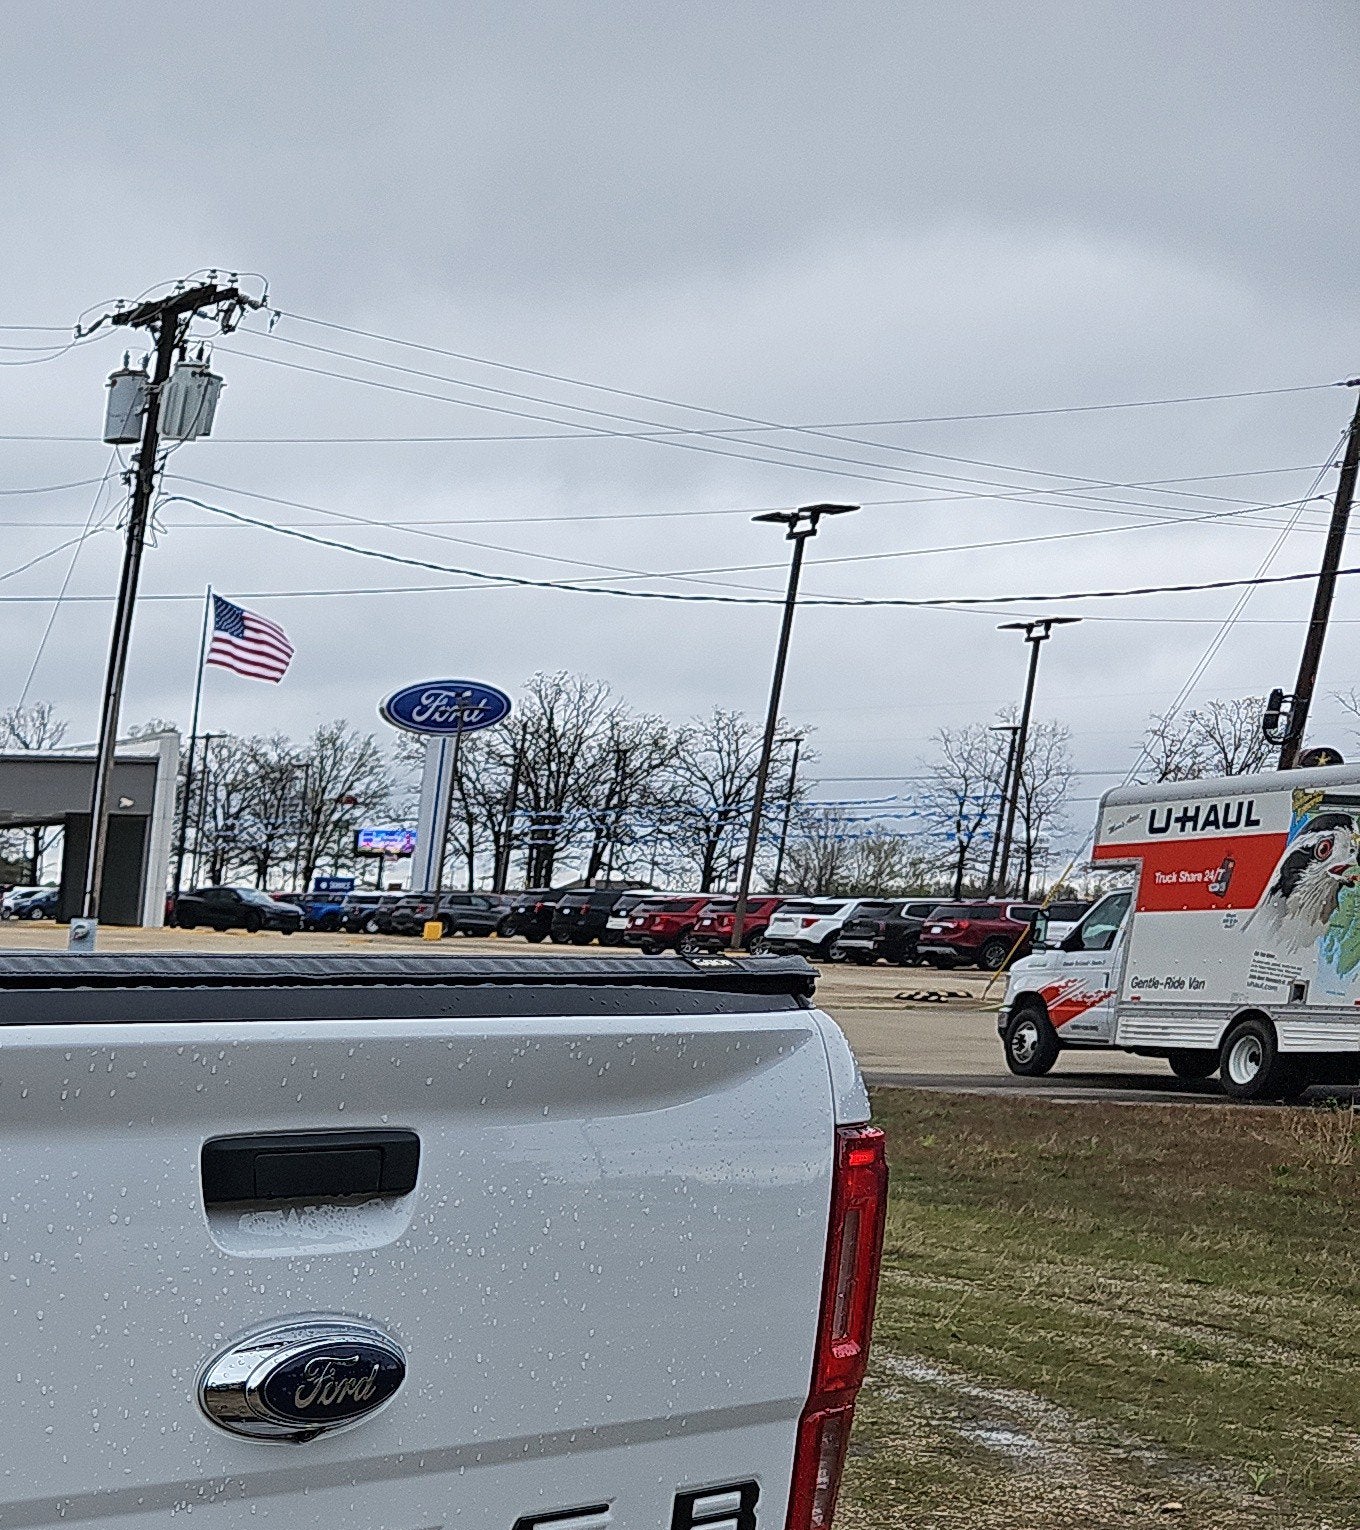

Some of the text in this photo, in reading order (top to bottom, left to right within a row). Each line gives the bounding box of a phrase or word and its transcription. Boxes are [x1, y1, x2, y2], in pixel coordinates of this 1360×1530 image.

[412, 689, 488, 723] Ford
[1147, 800, 1261, 834] U-HAUL
[1155, 871, 1177, 884] Truck
[1179, 870, 1203, 883] Share
[1187, 976, 1206, 990] Van
[295, 1354, 380, 1409] Ford
